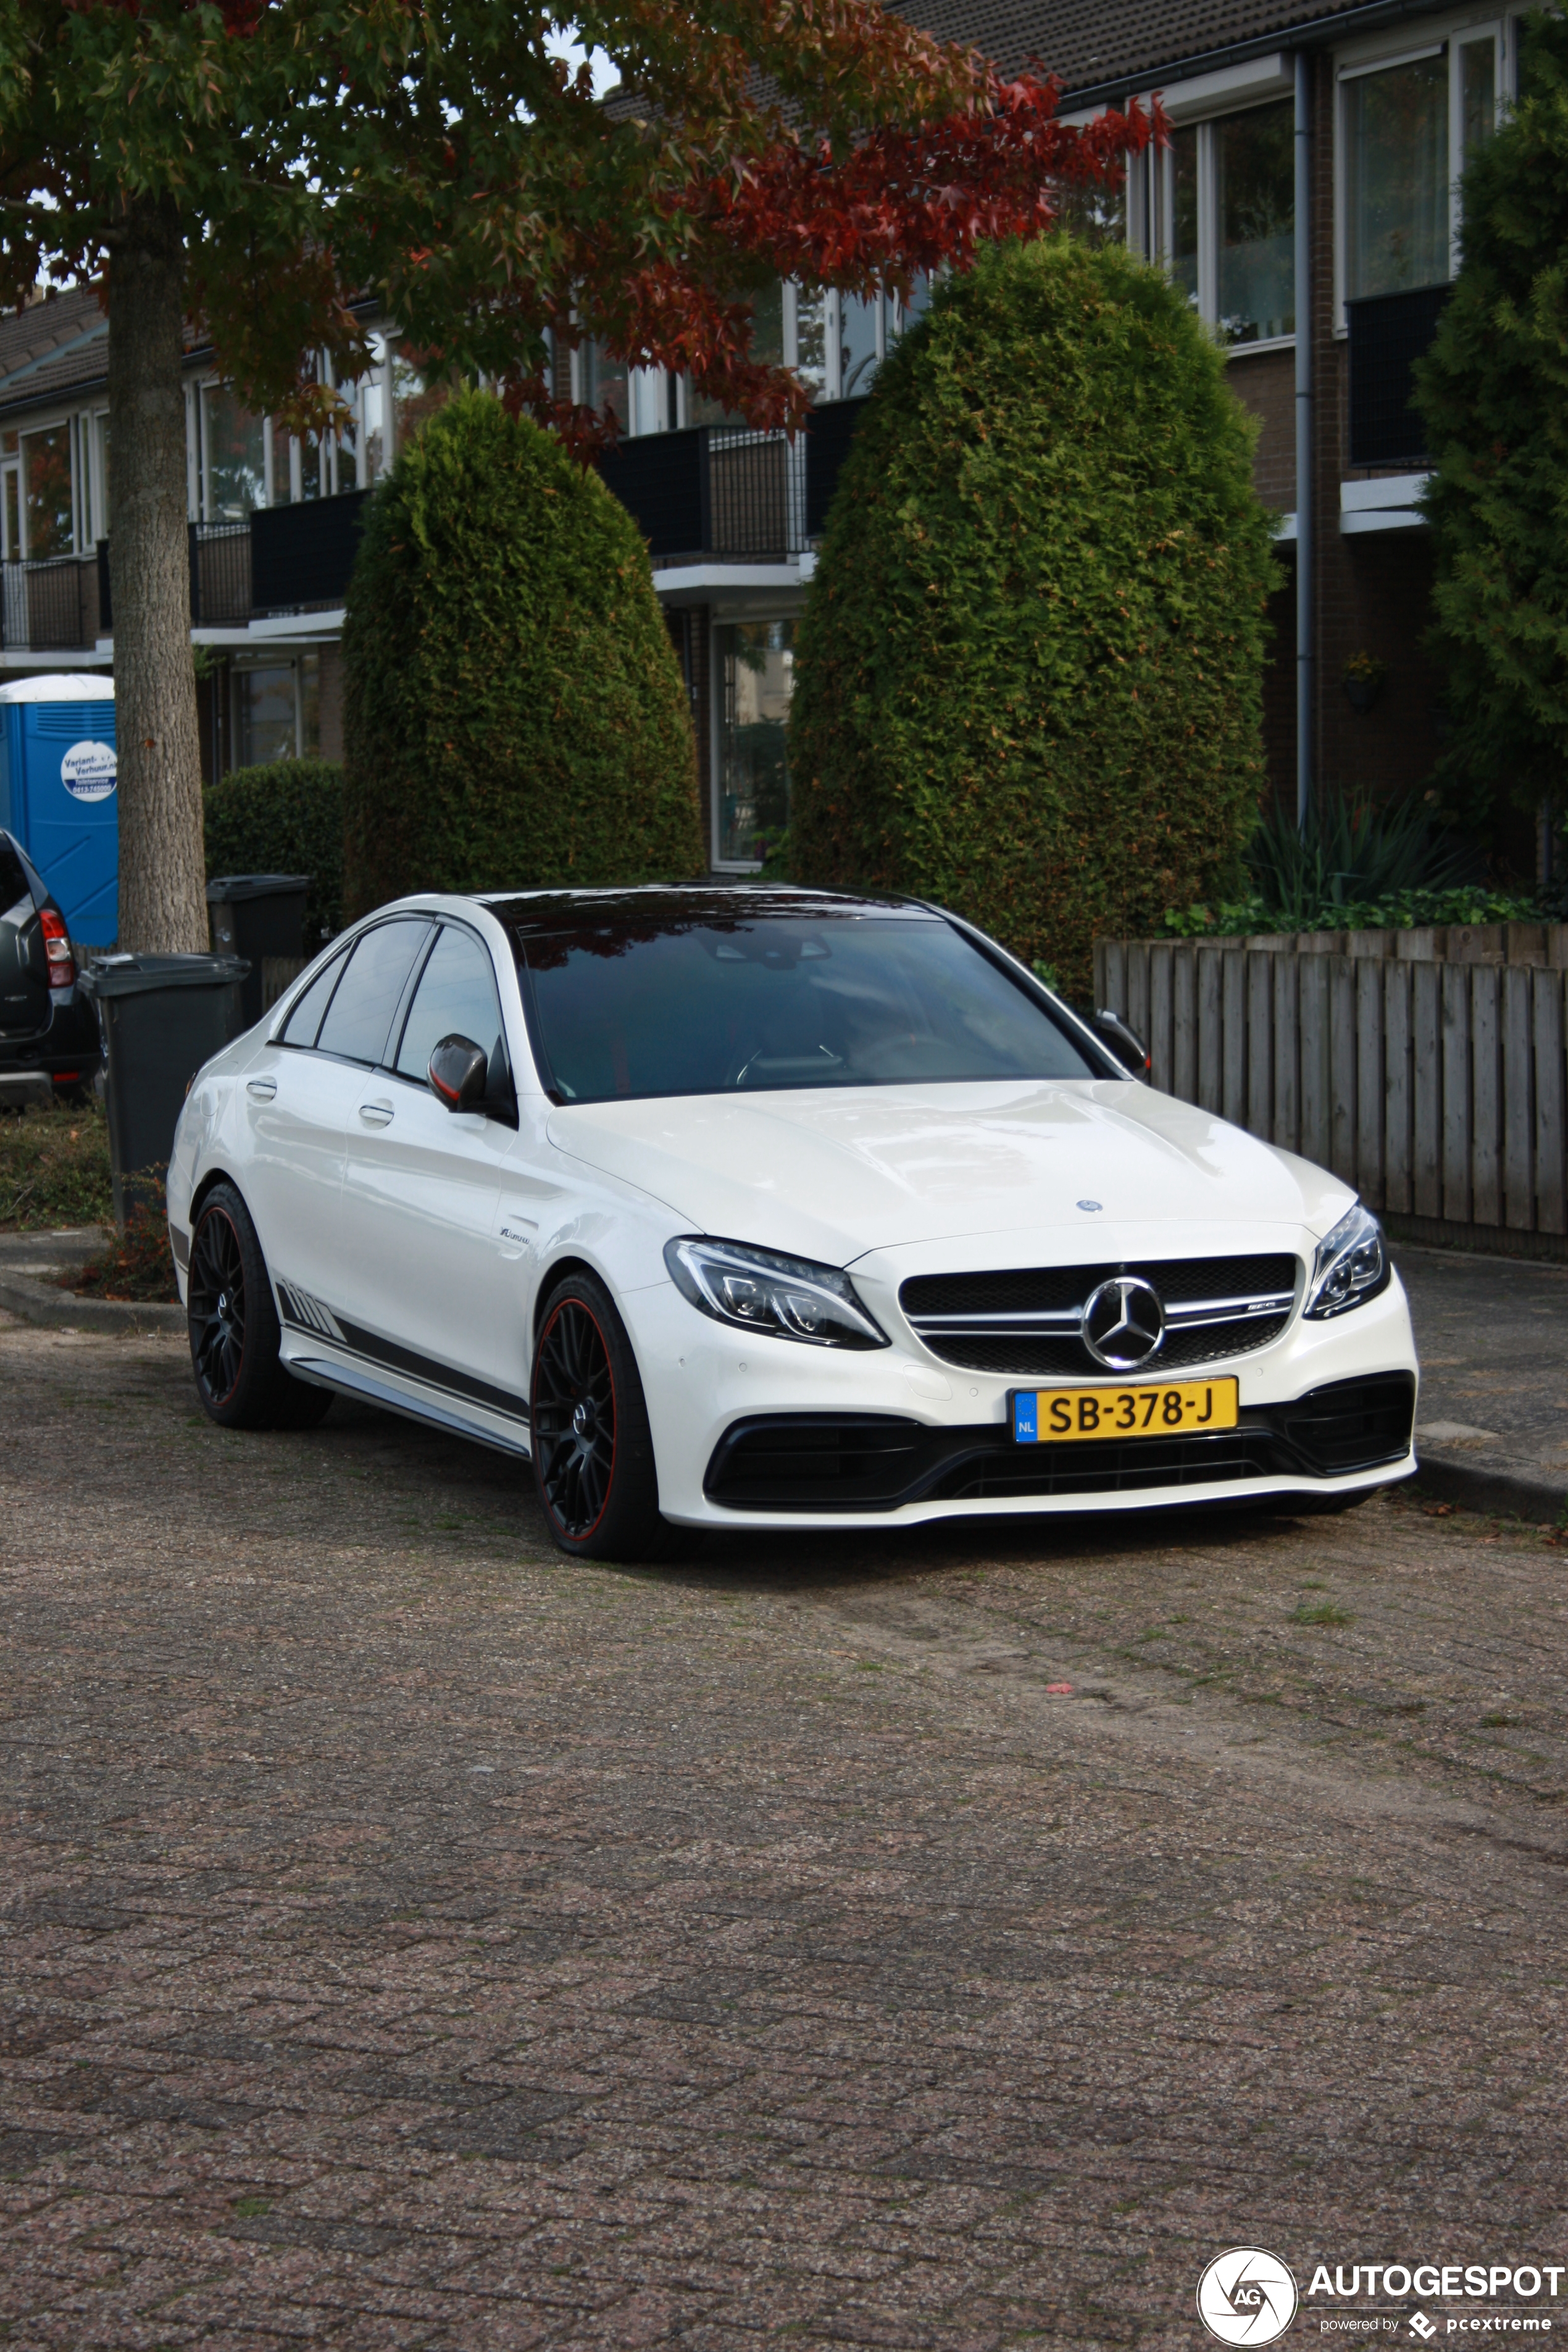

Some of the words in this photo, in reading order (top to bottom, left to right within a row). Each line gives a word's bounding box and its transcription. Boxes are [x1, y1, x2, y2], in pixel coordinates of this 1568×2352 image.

[65, 756, 96, 768] Variant-
[1049, 1387, 1212, 1433] SB-378-J
[1018, 1422, 1035, 1433] NL
